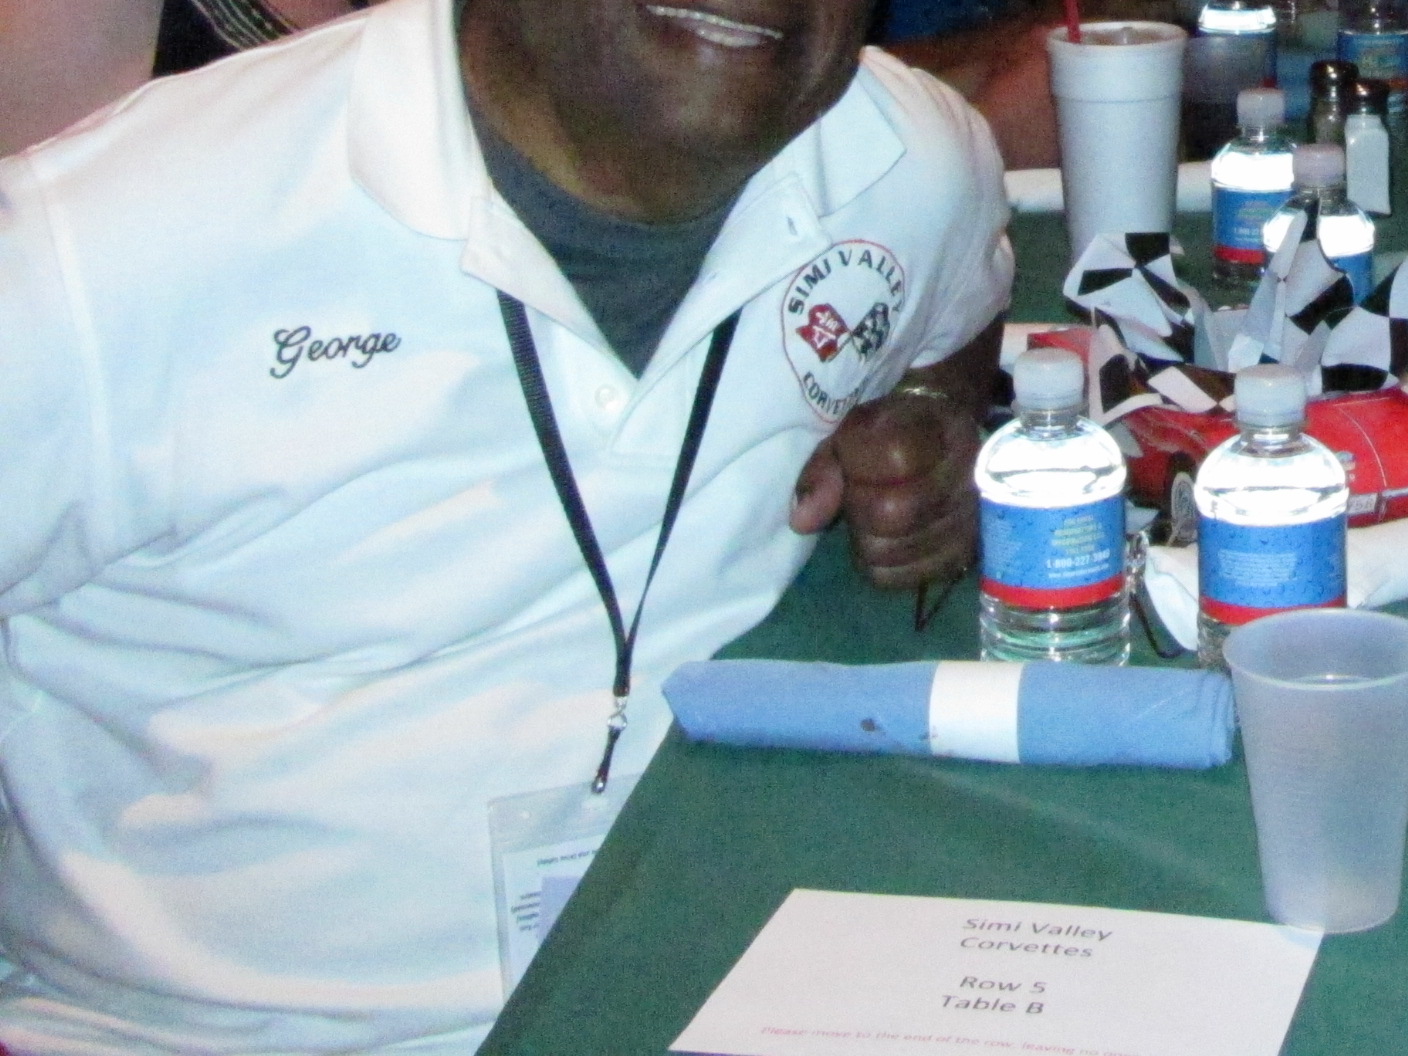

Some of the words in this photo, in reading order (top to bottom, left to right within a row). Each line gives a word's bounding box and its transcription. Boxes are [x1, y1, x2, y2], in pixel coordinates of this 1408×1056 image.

[788, 257, 833, 315] SIMI
[269, 325, 402, 379] George
[963, 917, 1022, 932] Simi
[1031, 921, 1114, 942] Valley
[959, 936, 1093, 958] Corvettes
[959, 975, 1022, 993] Row
[1029, 981, 1047, 994] 5
[941, 994, 1017, 1013] Table
[1025, 1001, 1045, 1015] B
